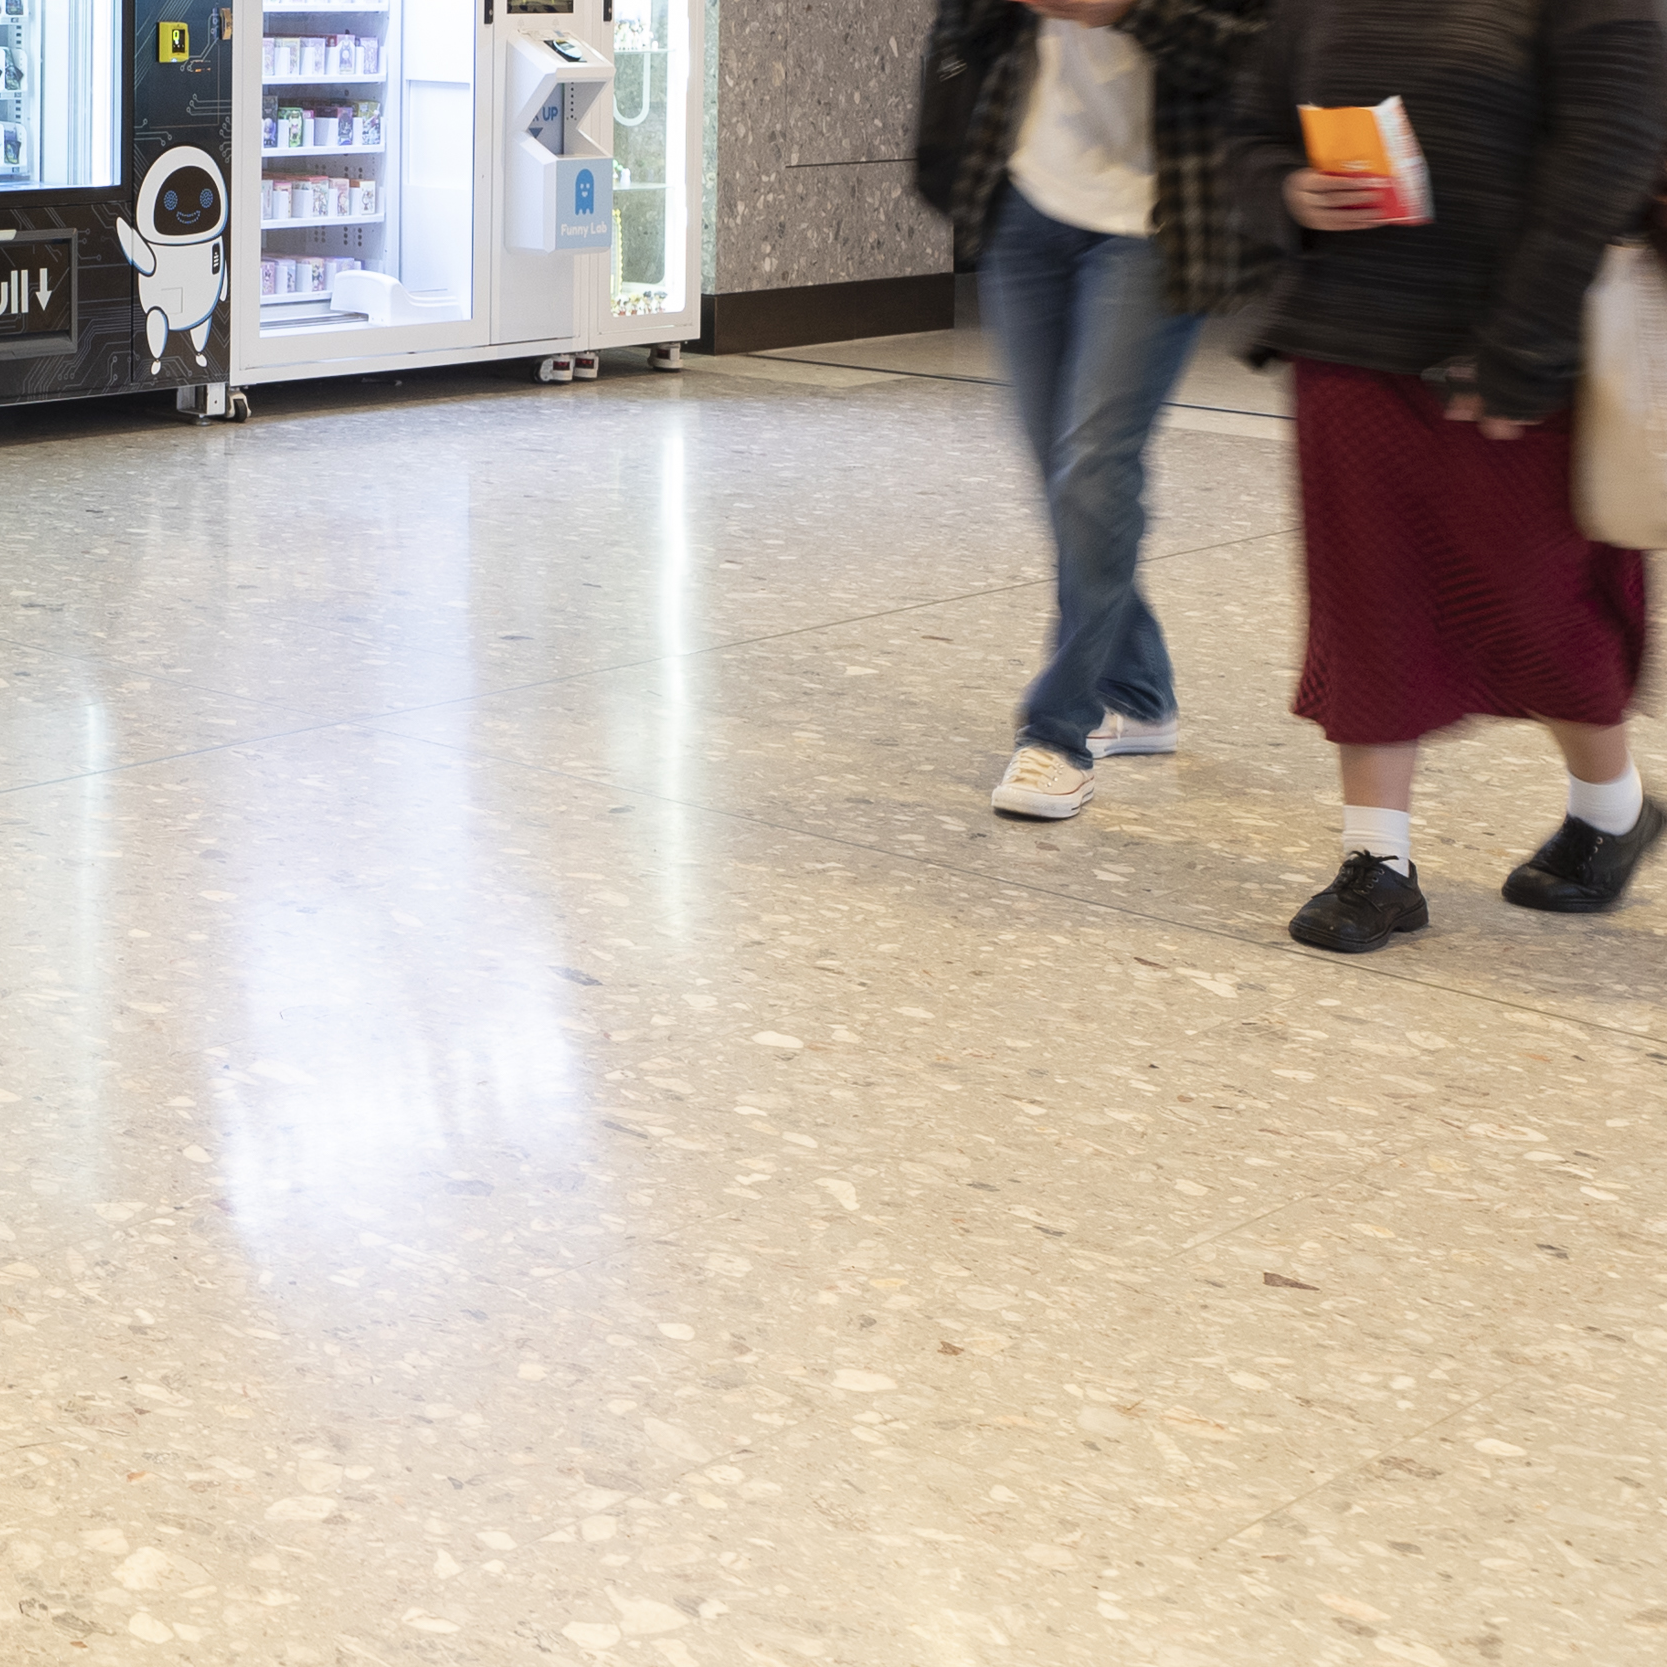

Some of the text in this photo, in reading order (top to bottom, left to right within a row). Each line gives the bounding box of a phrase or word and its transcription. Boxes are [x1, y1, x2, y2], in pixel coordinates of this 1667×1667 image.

[542, 106, 559, 121] UP
[561, 221, 607, 238] Funny Lab
